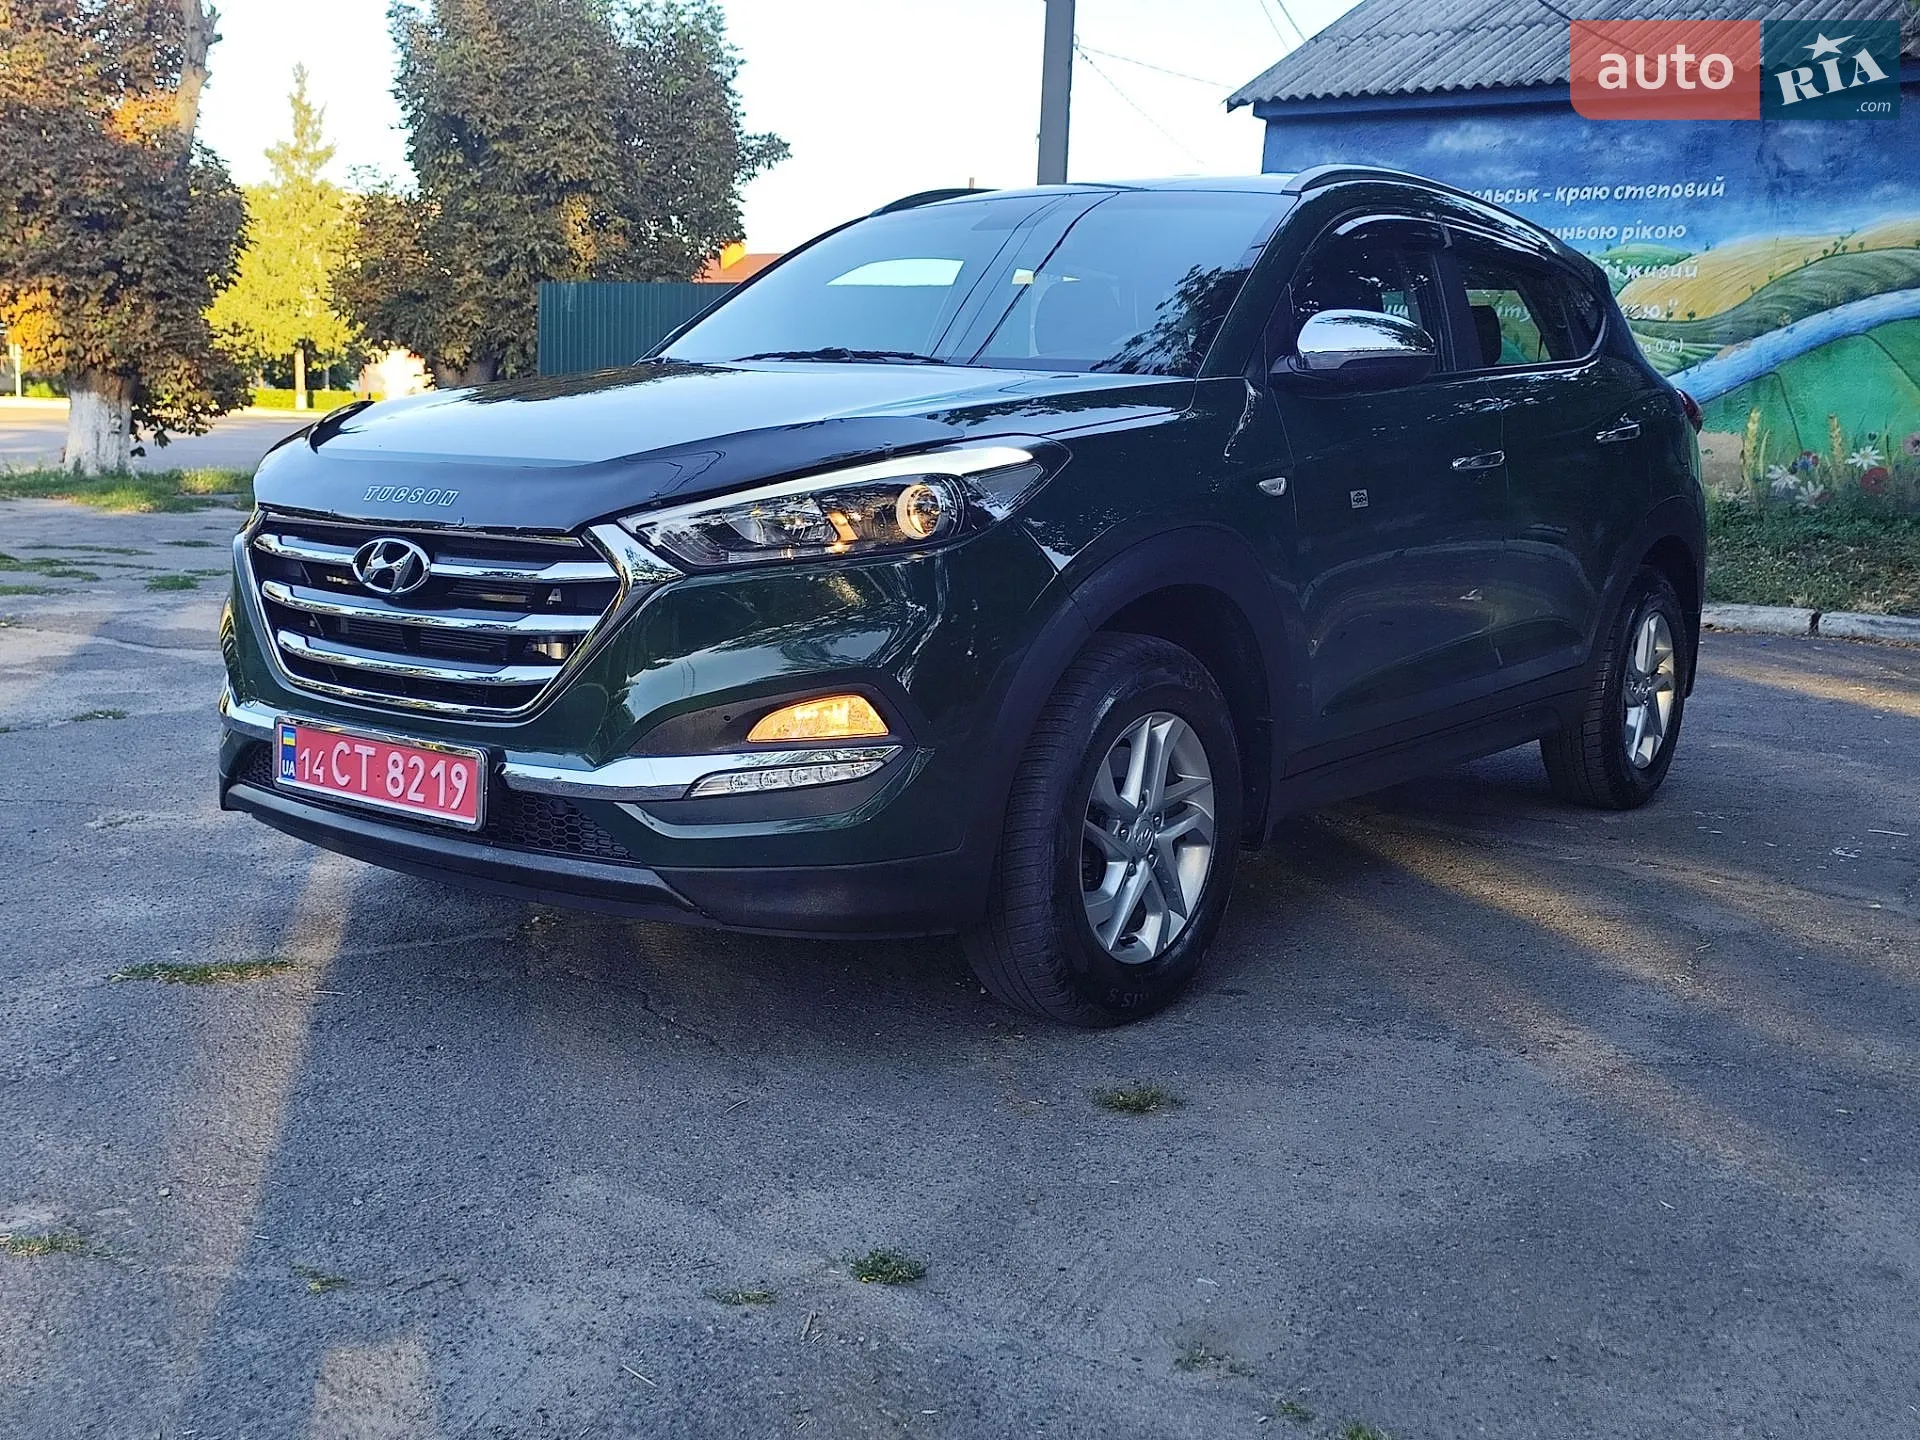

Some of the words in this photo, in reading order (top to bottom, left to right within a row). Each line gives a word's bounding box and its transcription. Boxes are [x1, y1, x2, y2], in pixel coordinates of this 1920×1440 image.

[1555, 185, 1610, 206] краю
[1613, 176, 1726, 200] степовий
[1550, 226, 1618, 241] иньою
[1620, 219, 1687, 245] рікою
[363, 485, 460, 506] TUCSON
[282, 760, 296, 777] UA
[385, 751, 469, 810] 8219
